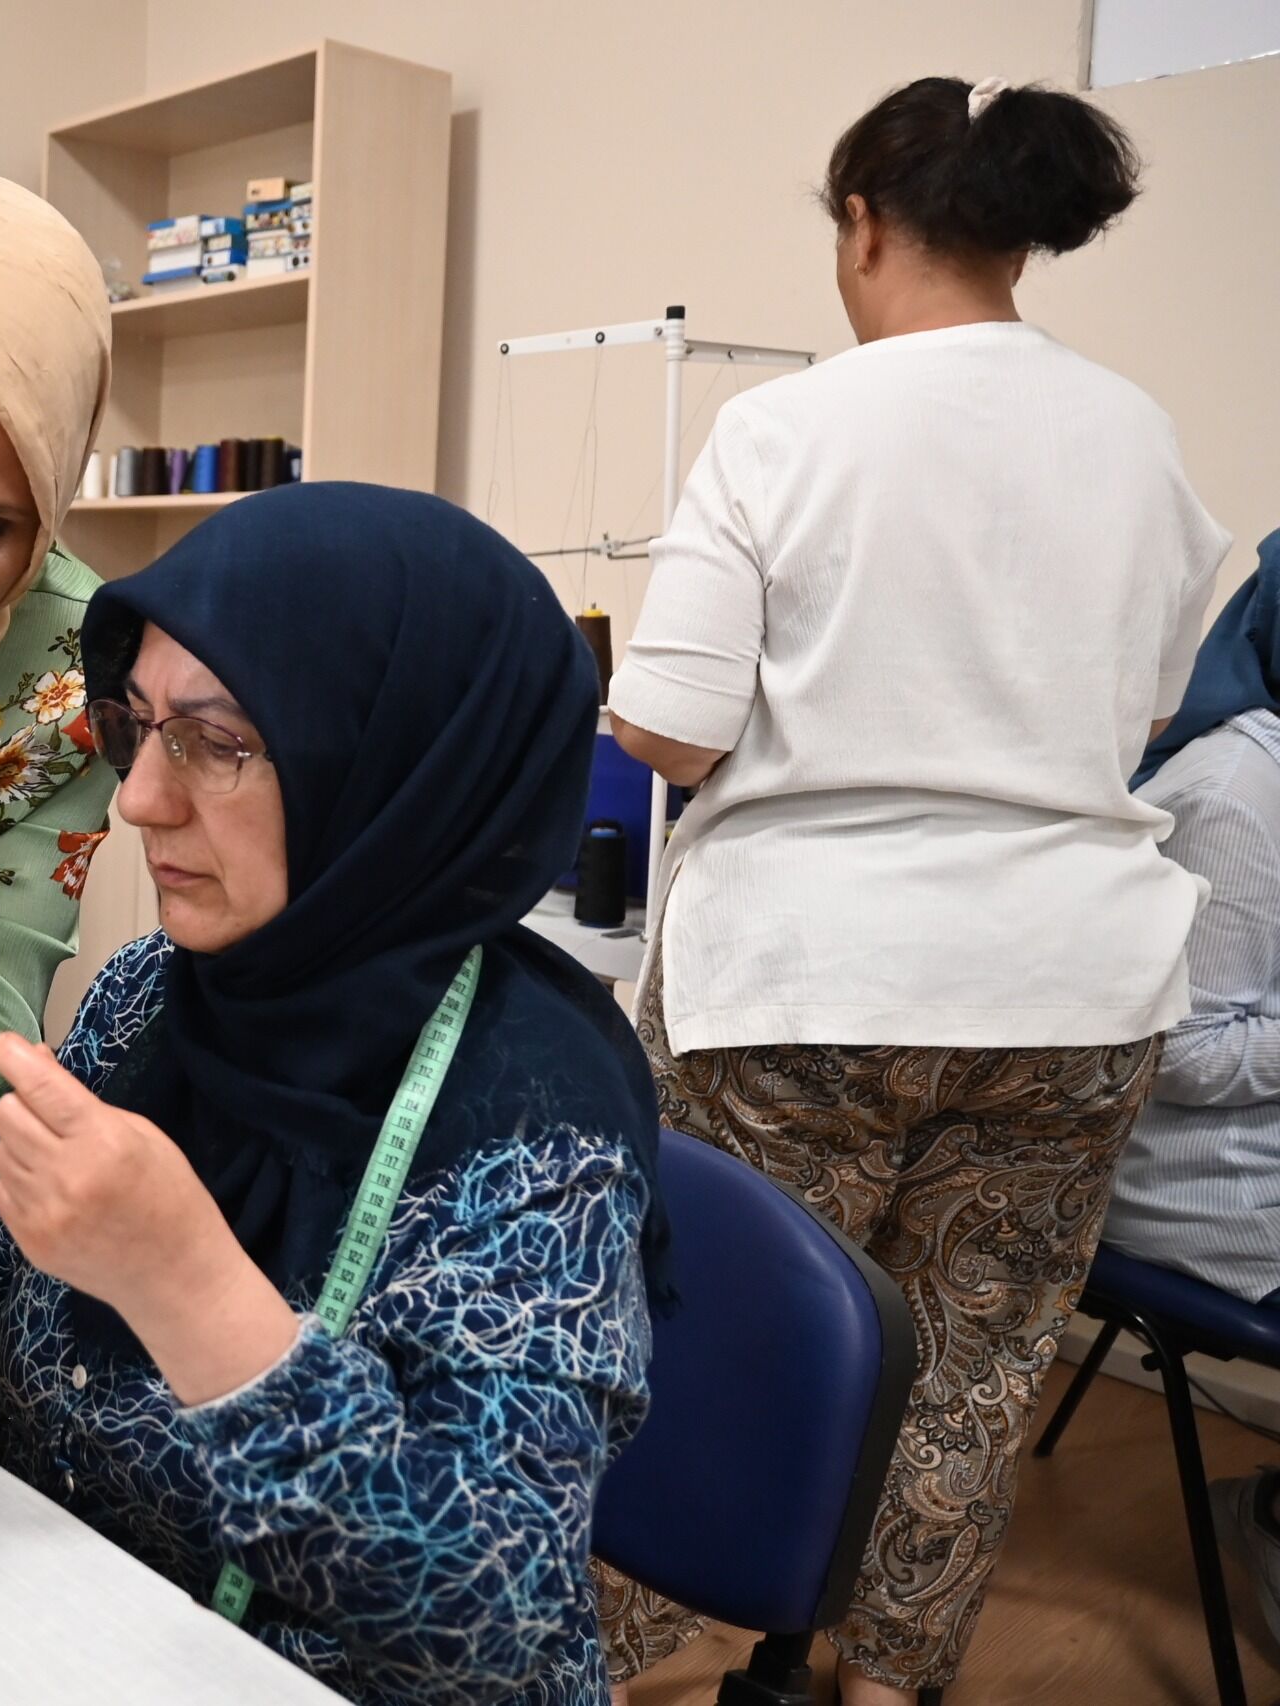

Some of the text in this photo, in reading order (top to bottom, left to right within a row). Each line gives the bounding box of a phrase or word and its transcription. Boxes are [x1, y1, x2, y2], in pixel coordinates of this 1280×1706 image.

[440, 1012, 455, 1026] 109
[433, 1030, 448, 1043] 110
[426, 1047, 440, 1061] 111
[419, 1065, 434, 1079] 112
[412, 1082, 426, 1096] 113
[404, 1099, 419, 1112] 114
[398, 1116, 413, 1131] 115
[391, 1134, 406, 1150] 116
[384, 1153, 399, 1168] 117
[377, 1172, 392, 1188] 118
[369, 1192, 385, 1208] 119
[362, 1211, 378, 1227] 120
[355, 1230, 370, 1246] 121
[348, 1249, 364, 1265] 122
[341, 1268, 356, 1284] 123
[333, 1287, 348, 1302] 124
[324, 1306, 339, 1322] 125
